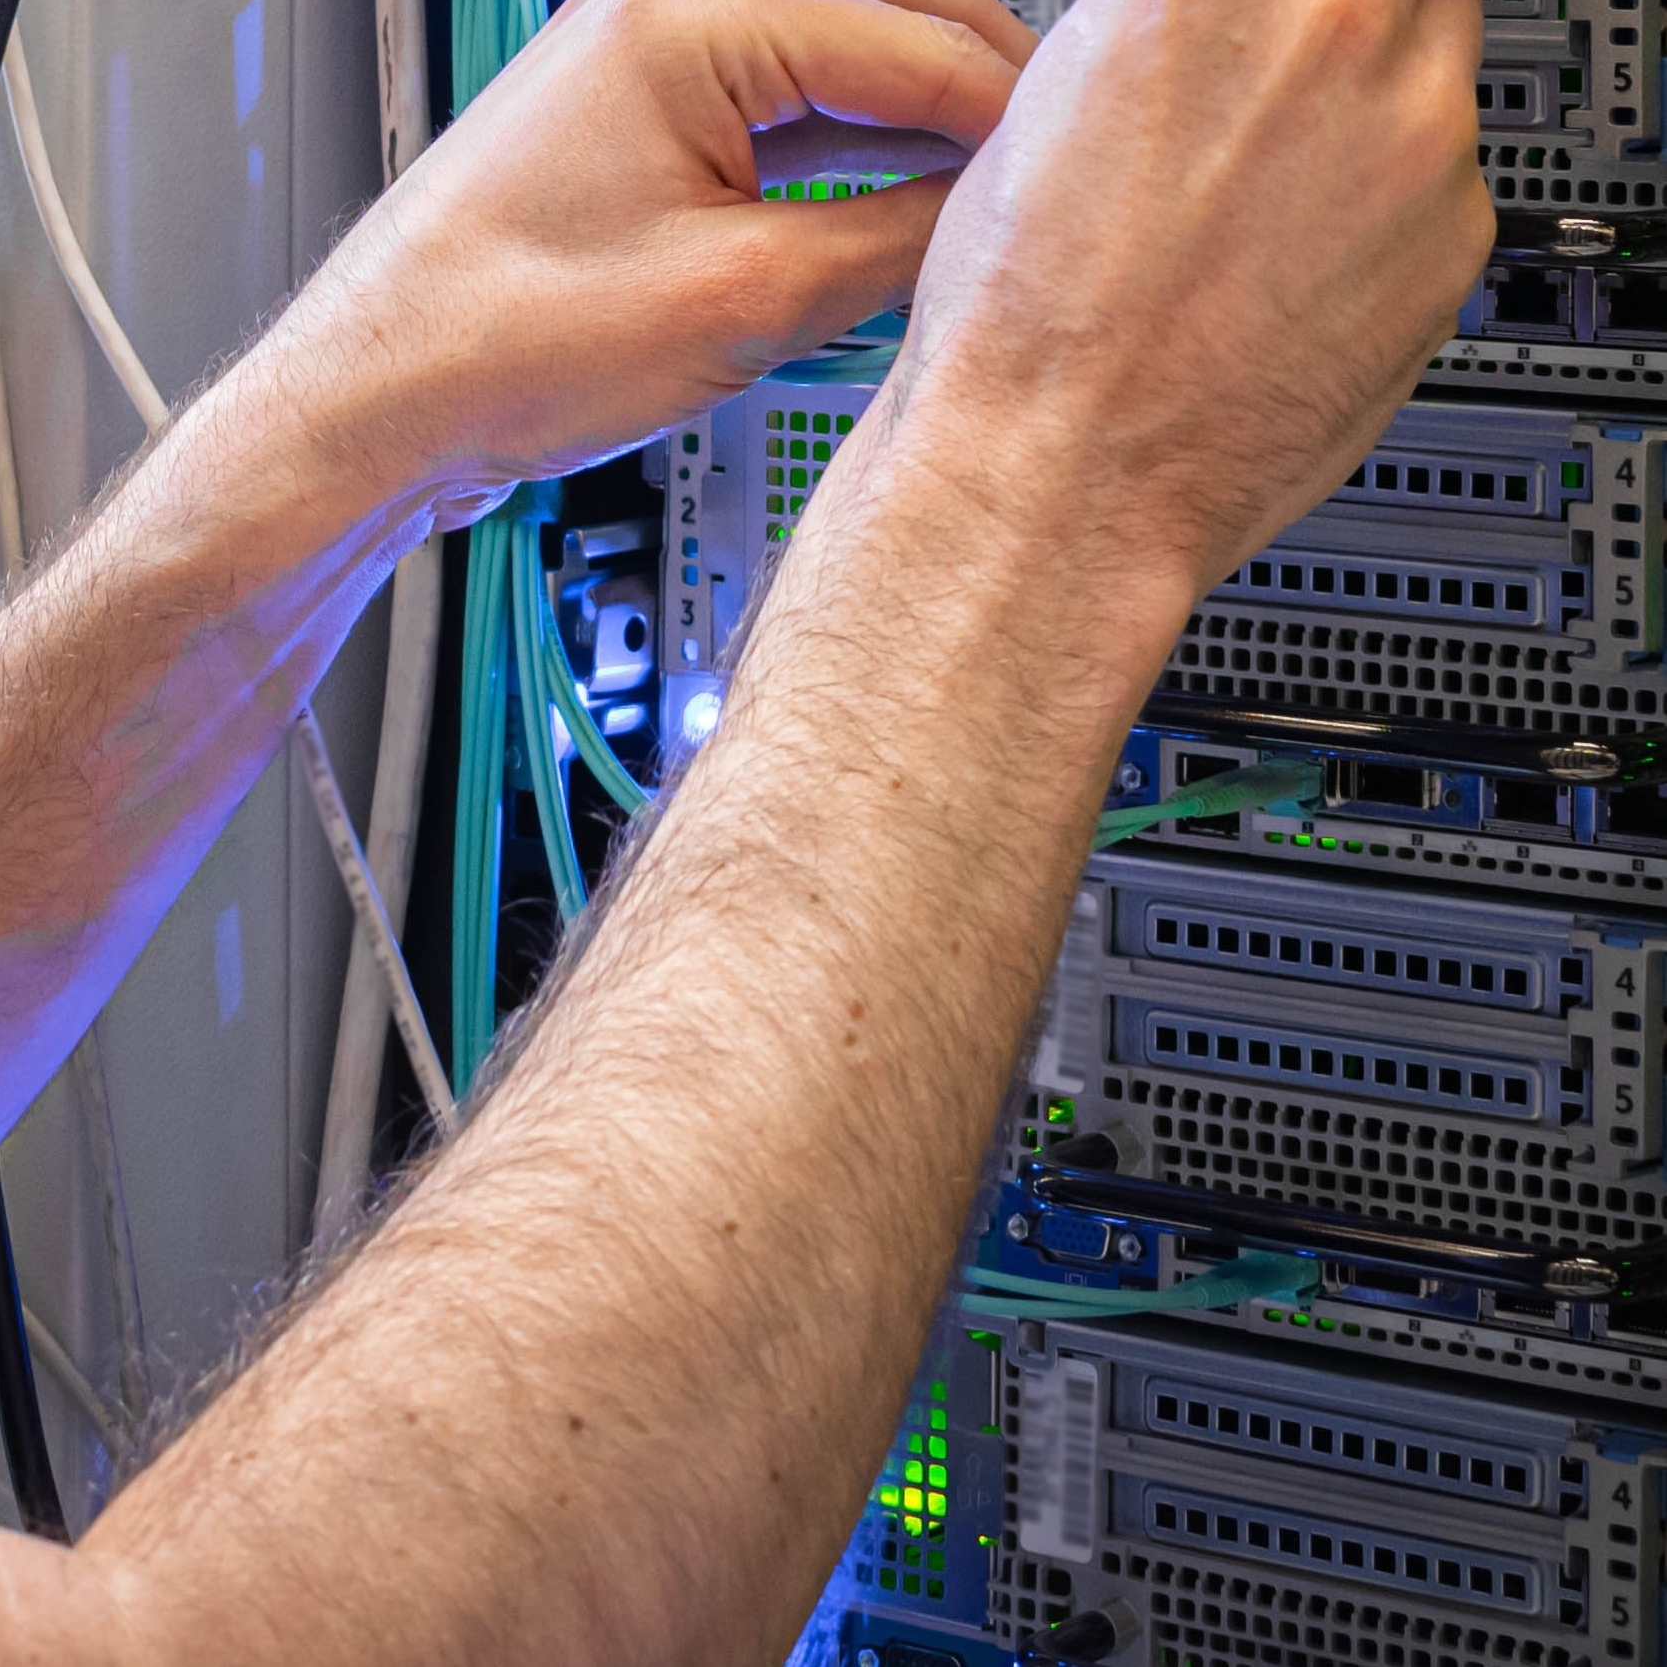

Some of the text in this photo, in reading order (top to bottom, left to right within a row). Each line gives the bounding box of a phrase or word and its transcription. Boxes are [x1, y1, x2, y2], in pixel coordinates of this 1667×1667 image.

[1614, 62, 1633, 93] 5
[1615, 457, 1636, 488] 4
[681, 497, 697, 524] 2
[1615, 575, 1634, 606] 5
[680, 599, 694, 626] 3
[1615, 967, 1636, 998] 4
[1615, 1084, 1634, 1114] 5
[1612, 1481, 1633, 1511] 4
[1611, 1596, 1630, 1627] 5
